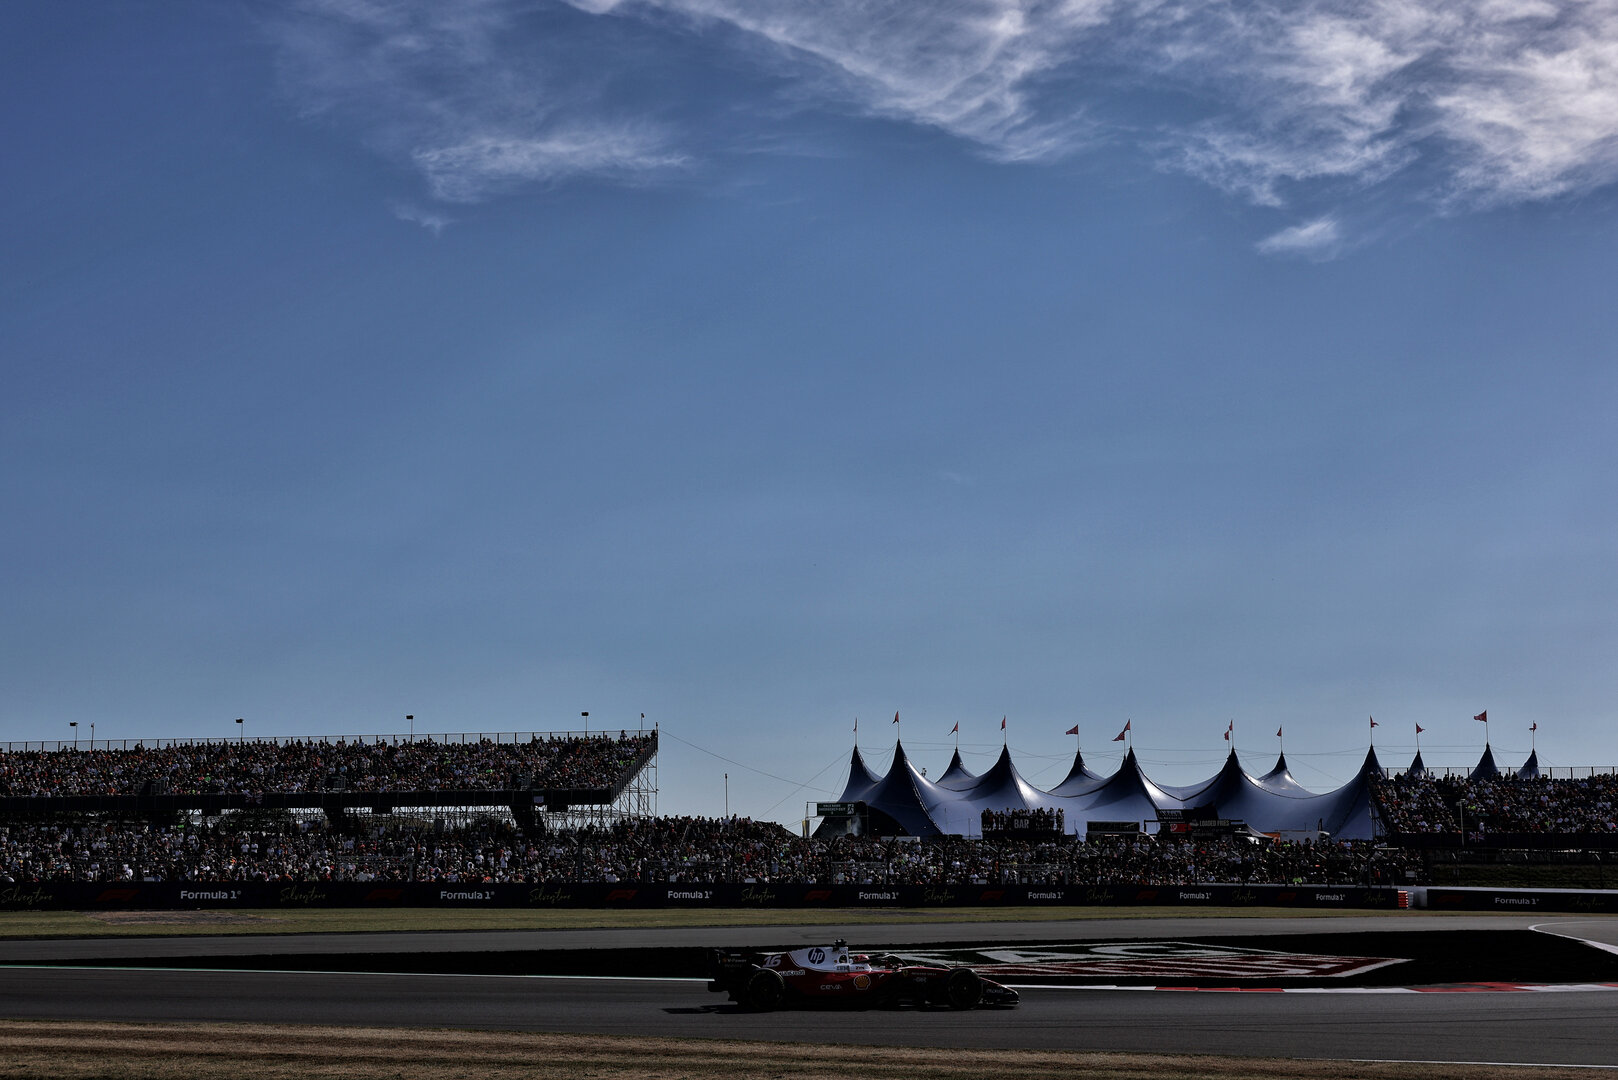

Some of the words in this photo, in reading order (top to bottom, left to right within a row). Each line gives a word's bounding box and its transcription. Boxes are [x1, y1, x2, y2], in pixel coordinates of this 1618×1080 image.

[1014, 819, 1030, 829] BAR
[180, 890, 228, 900] Formula
[440, 890, 483, 900] Formula
[667, 890, 703, 899] Formula
[859, 891, 891, 900] Formula
[1028, 891, 1057, 900] Formula
[1316, 893, 1339, 901] Formula
[1494, 897, 1530, 905] Formula
[810, 948, 824, 964] hp
[762, 955, 782, 968] 16
